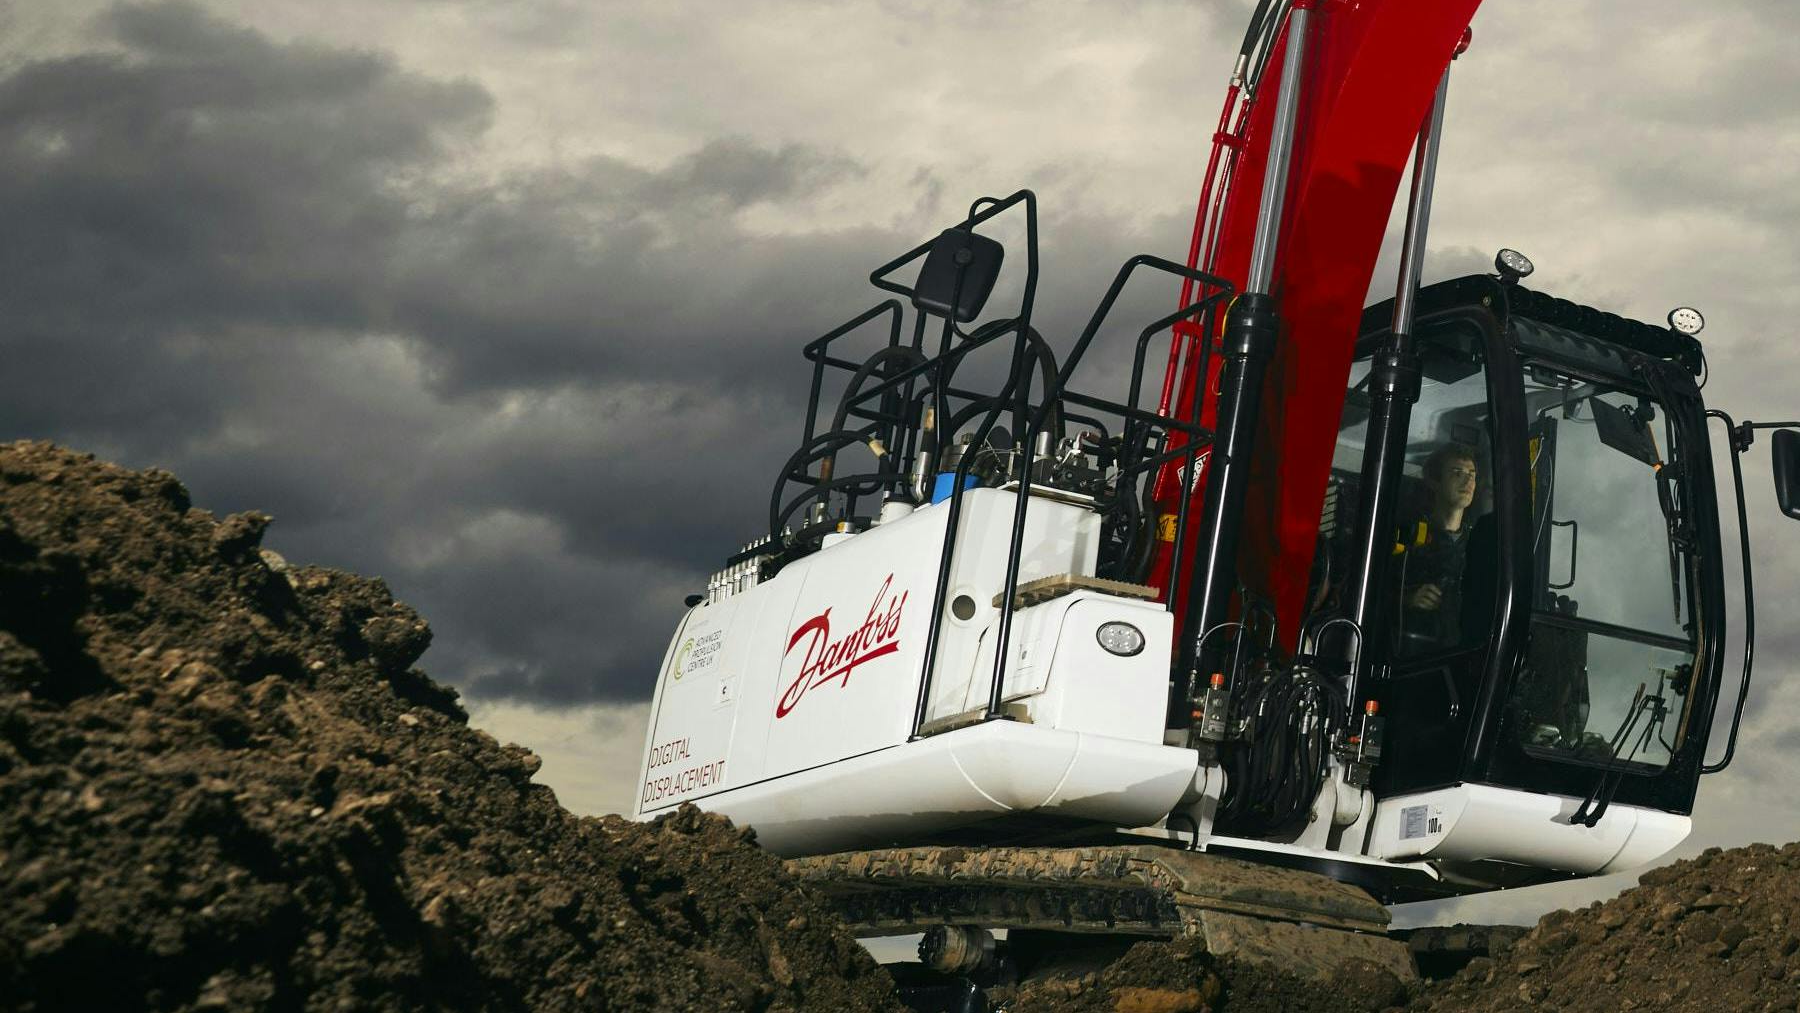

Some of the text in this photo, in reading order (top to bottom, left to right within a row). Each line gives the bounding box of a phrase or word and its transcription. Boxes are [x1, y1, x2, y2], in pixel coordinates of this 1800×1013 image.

[776, 572, 909, 719] Danfoss
[650, 737, 691, 769] DIGITAL
[644, 759, 725, 803] DISPLACEMENT
